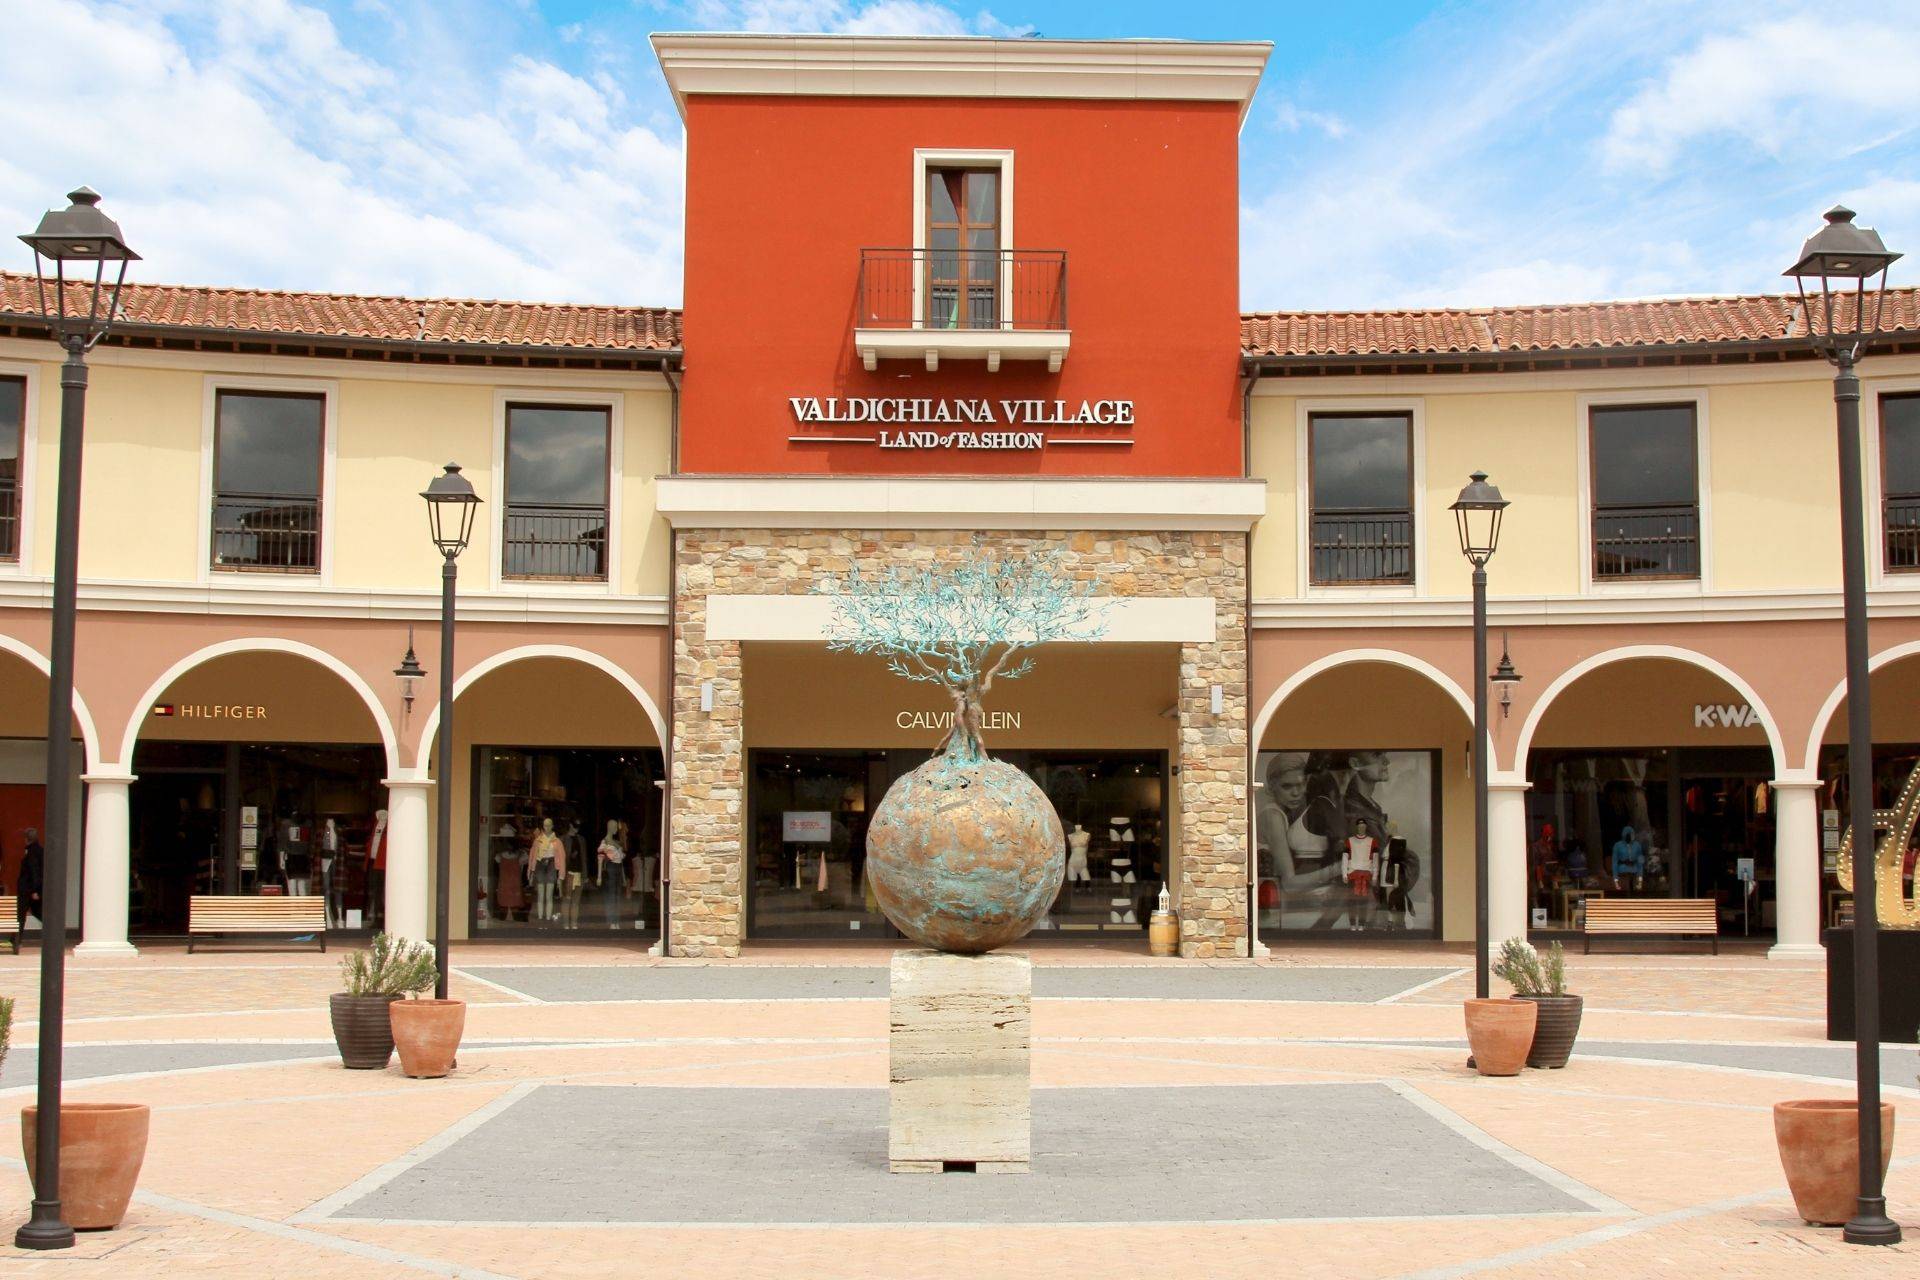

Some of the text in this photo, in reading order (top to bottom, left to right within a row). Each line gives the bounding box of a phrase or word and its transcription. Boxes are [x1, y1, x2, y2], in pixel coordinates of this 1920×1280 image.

[789, 397, 1135, 425] VALDICHIANA VILLAGE
[879, 431, 1044, 449] LAND of FASHION
[181, 704, 267, 719] HILFIGER
[978, 711, 1021, 729] LEIN
